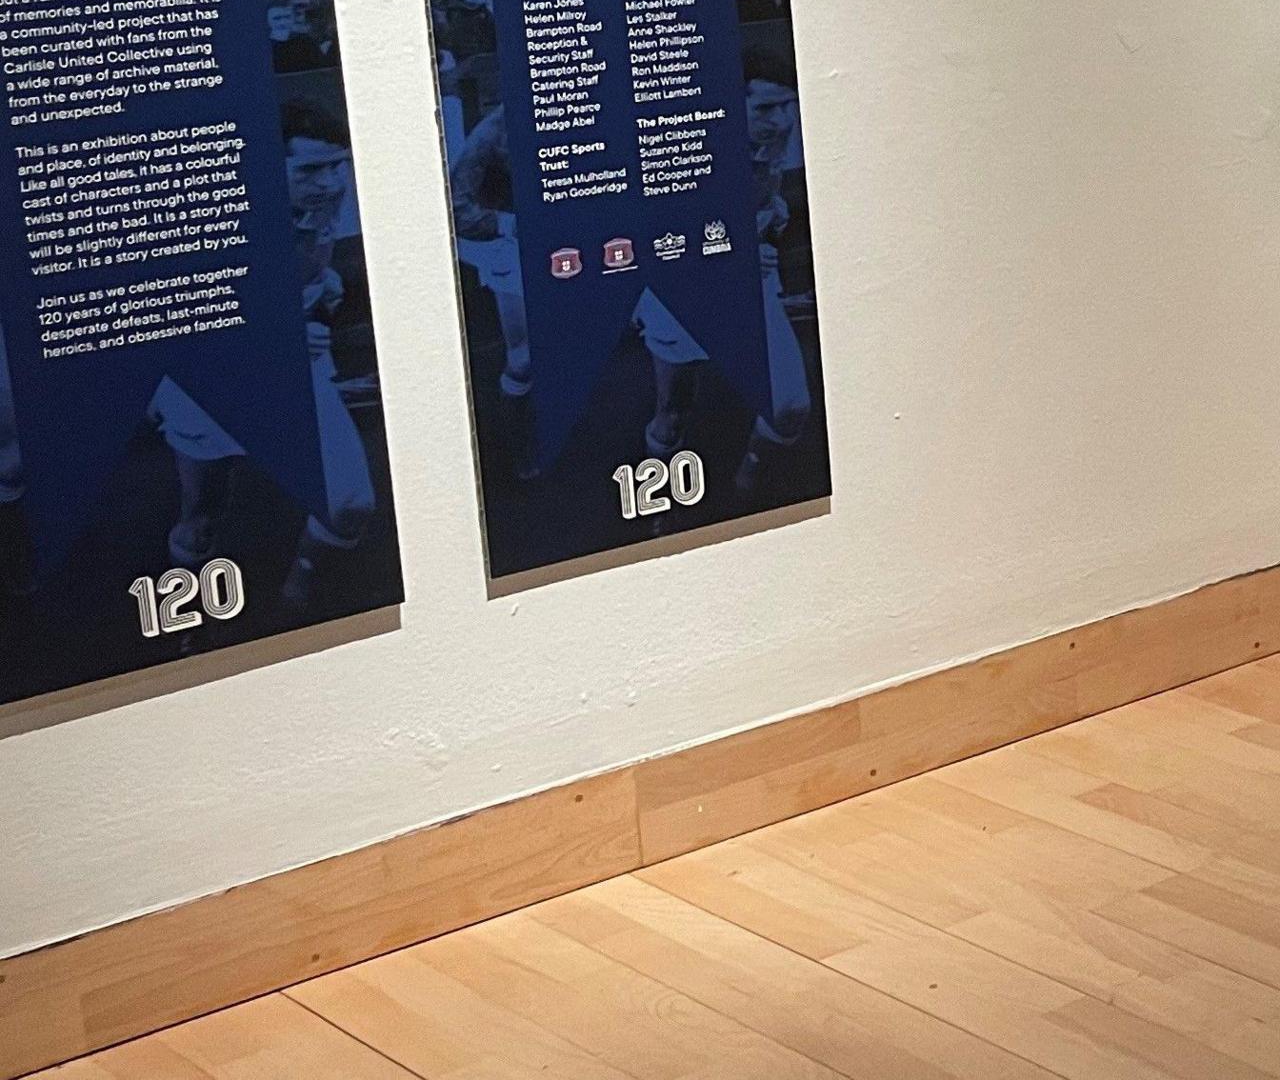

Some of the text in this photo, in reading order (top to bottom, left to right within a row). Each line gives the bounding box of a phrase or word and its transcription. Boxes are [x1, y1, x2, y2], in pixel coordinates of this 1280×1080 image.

[1, 26, 212, 57] been curated with fans from the
[526, 21, 602, 38] Brampton Road
[3, 43, 212, 74] Carlisle United Collective using
[8, 75, 223, 107] from the everyday to the strange
[636, 109, 725, 128] The Project Board:
[15, 121, 236, 158] This is an exhibition about people
[538, 142, 605, 158] CUFC Sports
[539, 160, 569, 171] Trust:
[643, 181, 697, 196] Steve Dunn
[38, 285, 235, 325] 120 years of glorious triumphs,
[613, 451, 704, 517] 120
[130, 559, 244, 635] 120
